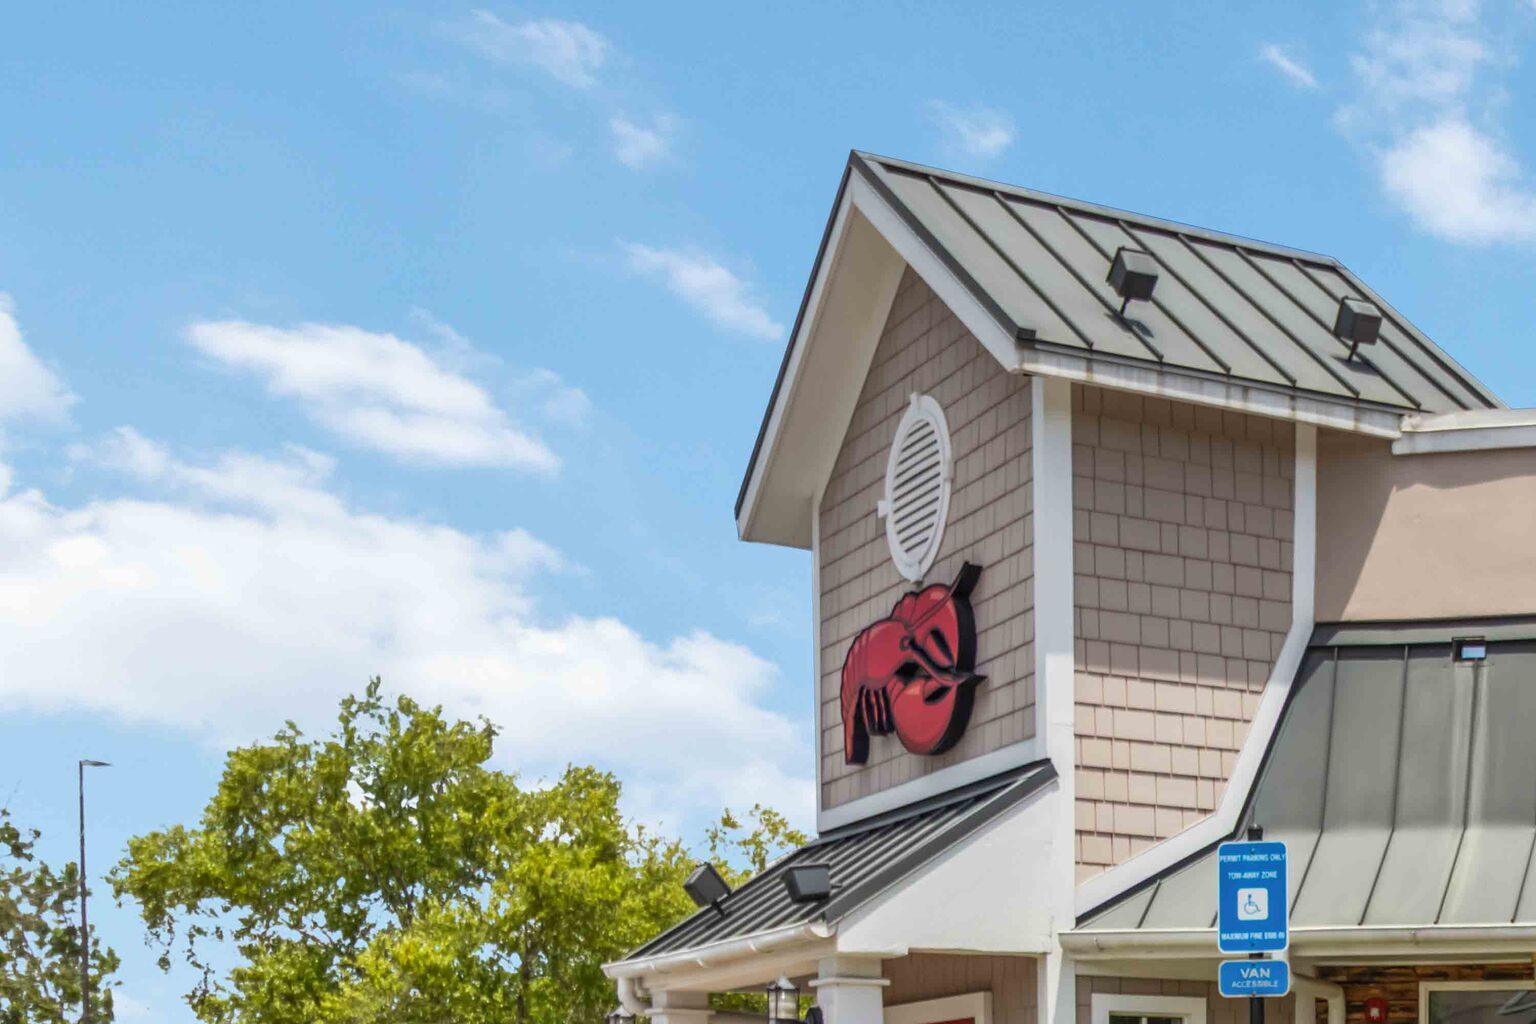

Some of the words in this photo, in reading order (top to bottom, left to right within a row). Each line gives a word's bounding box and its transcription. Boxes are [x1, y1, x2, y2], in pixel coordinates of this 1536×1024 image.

[1242, 854, 1269, 862] PARKING
[1270, 853, 1286, 862] ONLY
[1261, 870, 1278, 879] ZONE
[1240, 968, 1270, 979] VAN
[1232, 980, 1279, 989] ACCESSIBLE
